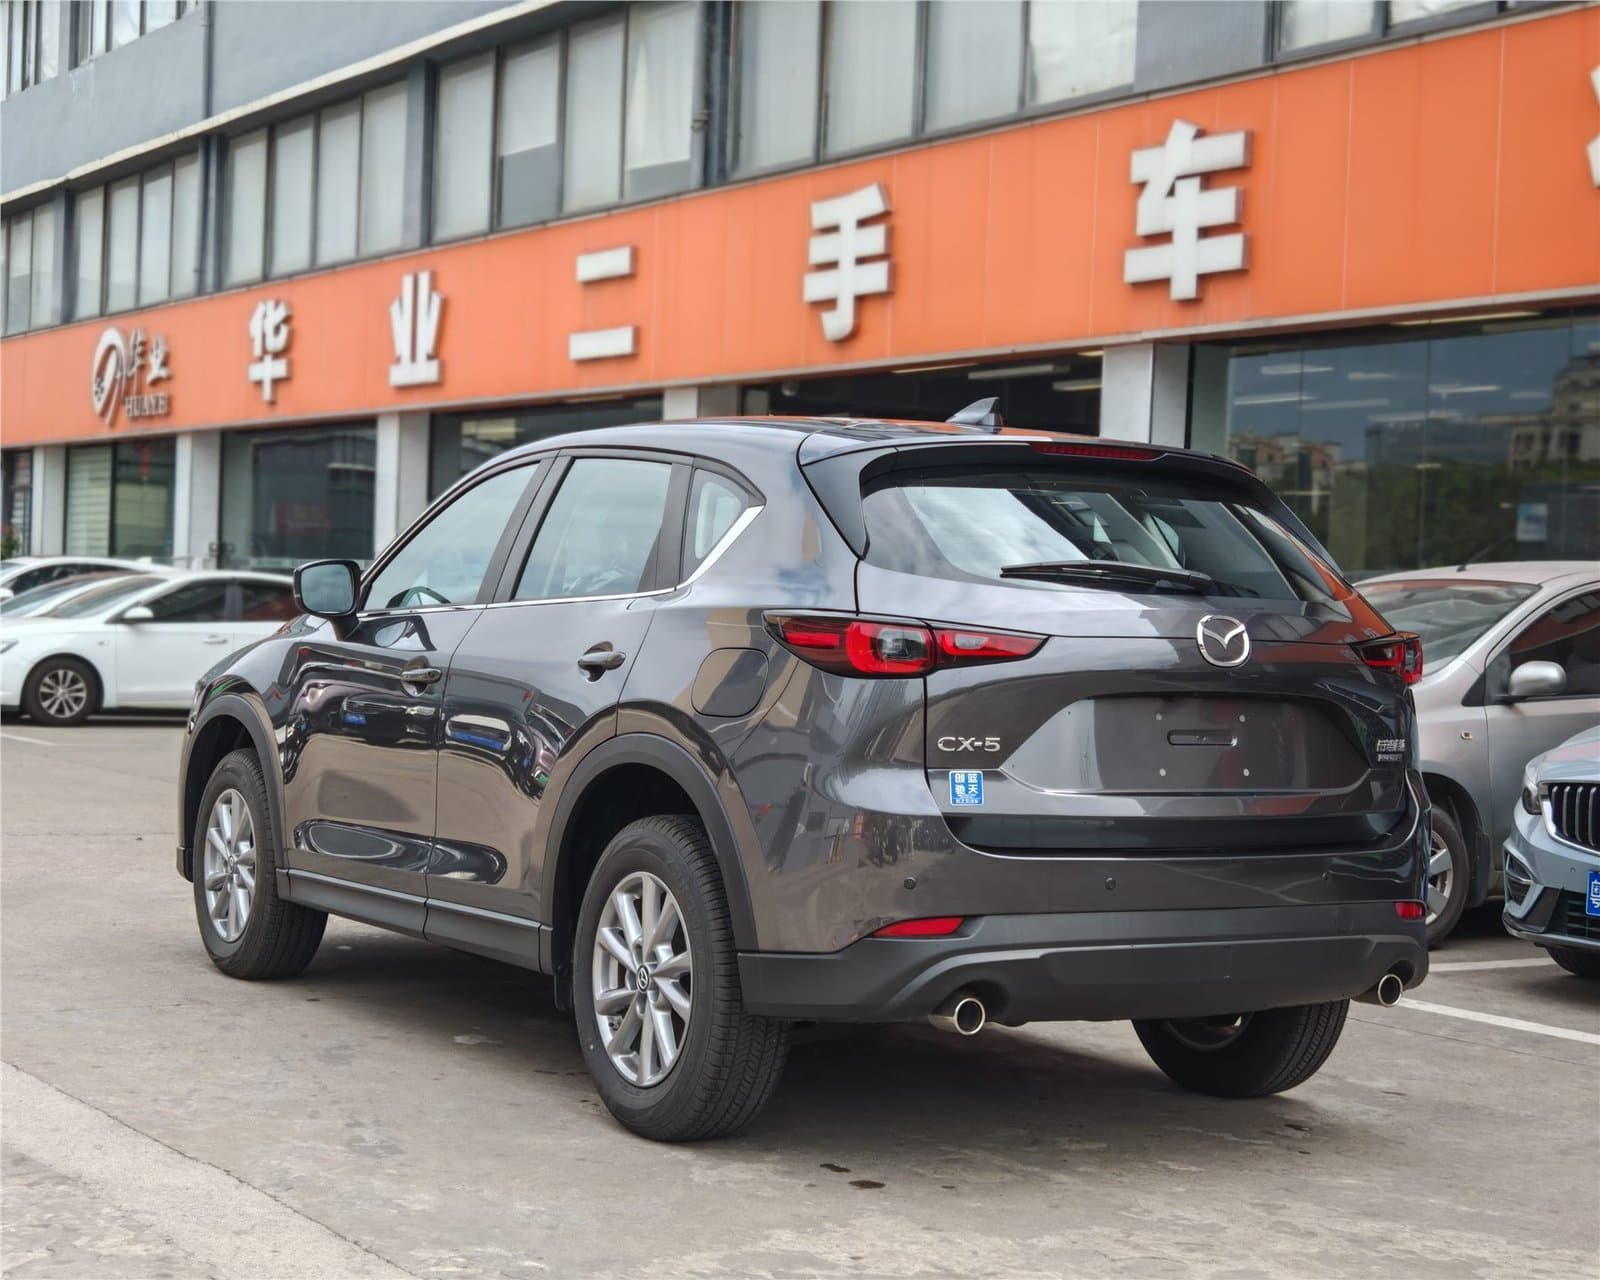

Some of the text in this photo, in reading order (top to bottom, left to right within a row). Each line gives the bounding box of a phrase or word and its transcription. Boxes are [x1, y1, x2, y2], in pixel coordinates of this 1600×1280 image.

[248, 64, 1600, 404] 华业二手车
[937, 736, 1001, 752] CX-5
